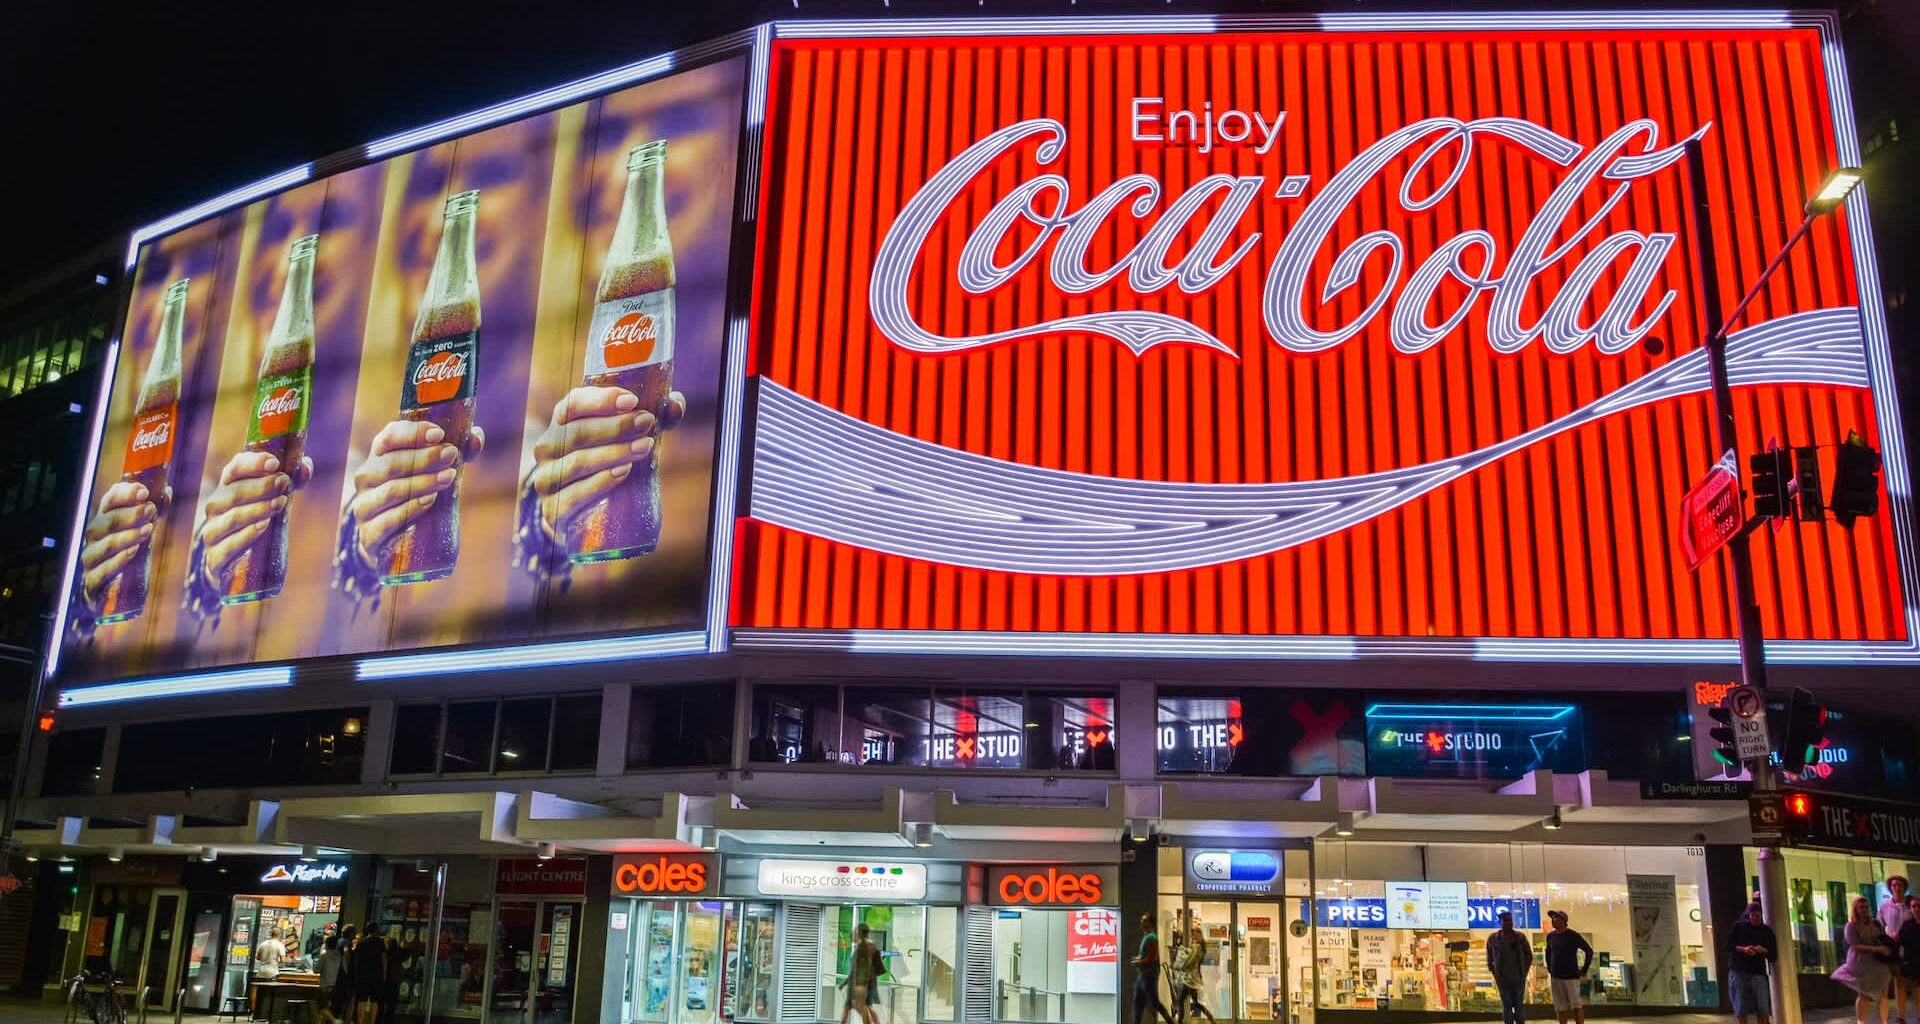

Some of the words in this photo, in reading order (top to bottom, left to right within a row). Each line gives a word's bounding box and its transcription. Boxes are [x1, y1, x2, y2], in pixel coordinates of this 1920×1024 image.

[1131, 96, 1288, 155] Enjoy
[433, 341, 454, 353] zero
[1740, 721, 1759, 732] NO
[1190, 724, 1226, 748] THE
[1396, 732, 1423, 747] THE
[1445, 732, 1501, 751] STUDIO
[1738, 735, 1765, 744] RIGHT
[923, 737, 955, 761] THE
[1742, 744, 1767, 754] TURN
[1662, 782, 1721, 795] Darlinghurst
[1724, 783, 1737, 794] Rd
[1821, 805, 1853, 838] THE
[502, 871, 539, 882] FLIGHT
[542, 871, 585, 882] CENTRE
[616, 857, 705, 893] coles
[781, 872, 817, 889] kings
[819, 876, 851, 888] cross
[853, 877, 898, 889] centre
[999, 868, 1102, 904] coles
[1073, 944, 1089, 956] The
